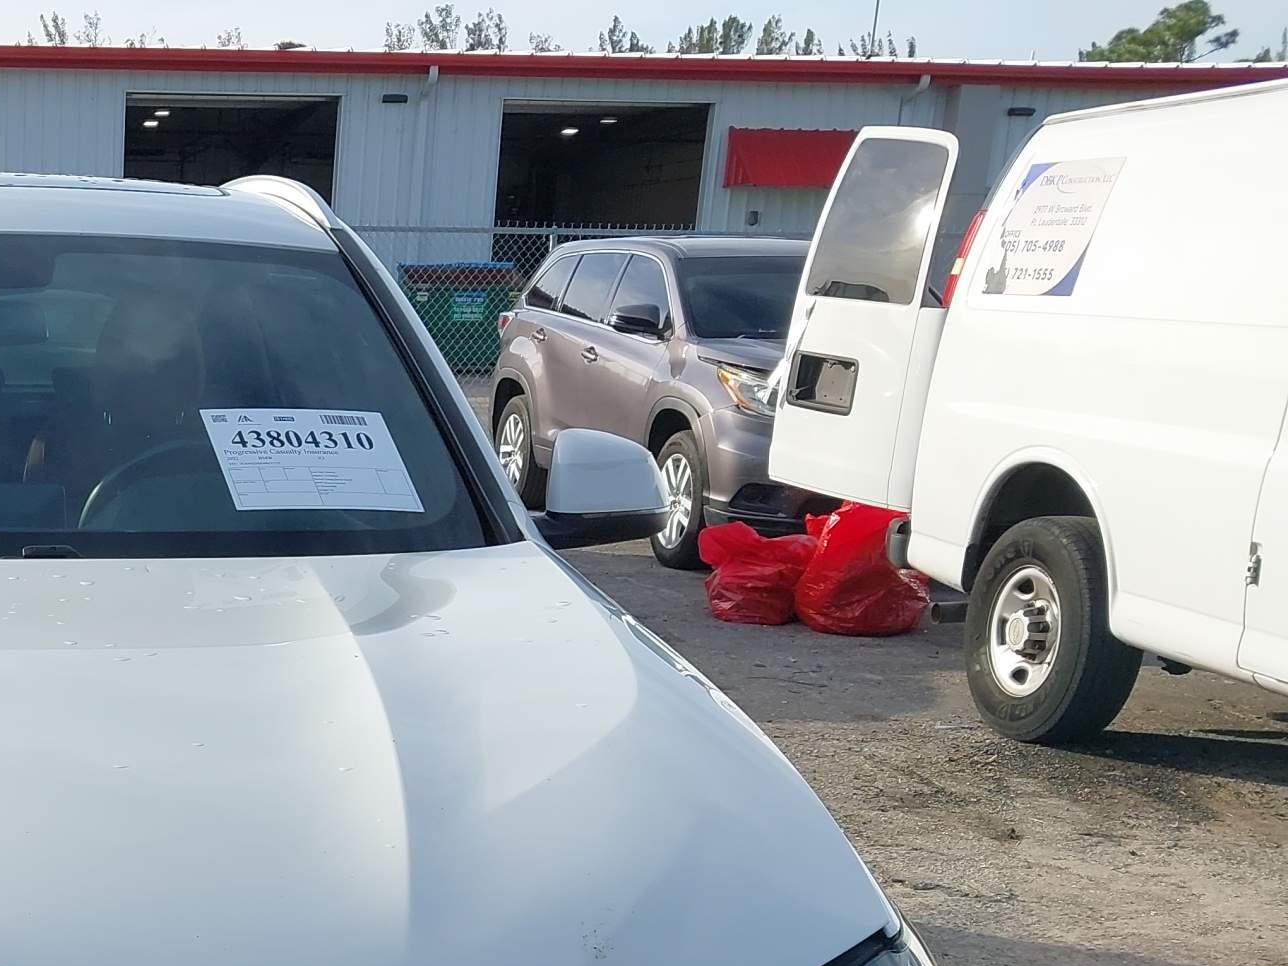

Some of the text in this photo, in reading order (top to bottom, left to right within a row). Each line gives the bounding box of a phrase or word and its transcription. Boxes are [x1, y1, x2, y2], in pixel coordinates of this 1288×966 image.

[1022, 239, 1066, 253] 705-4988
[1011, 267, 1054, 281] 721-1555
[231, 429, 374, 450] 43804310
